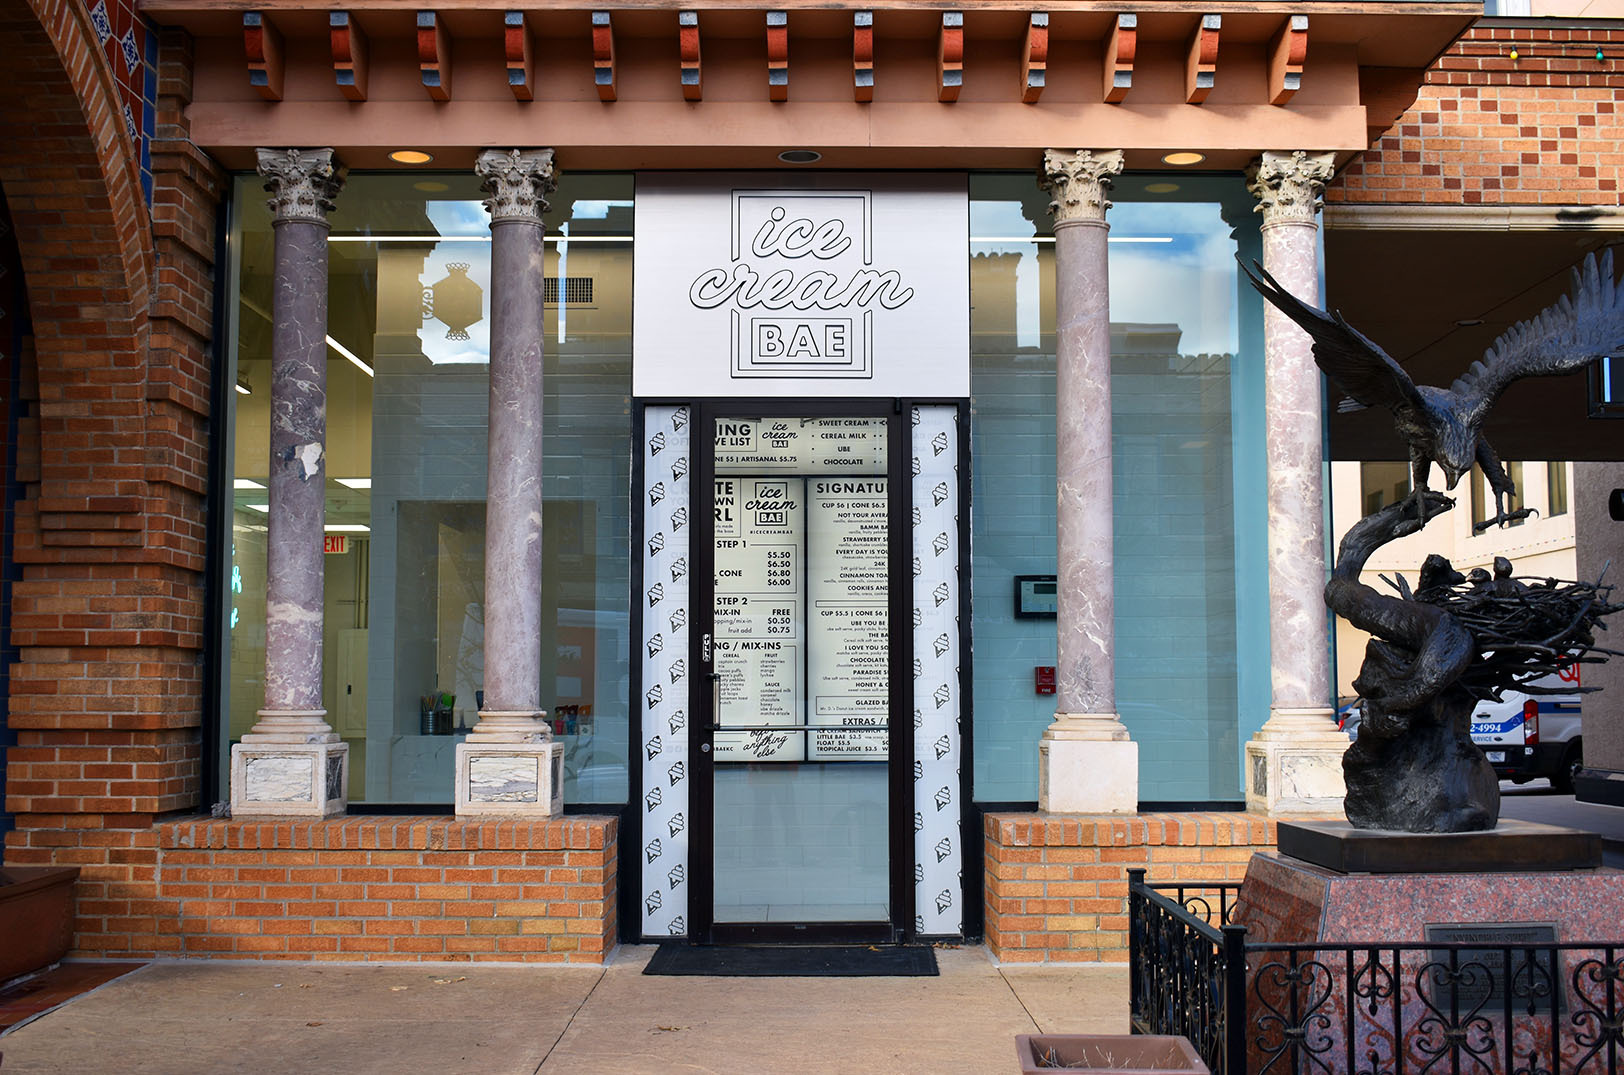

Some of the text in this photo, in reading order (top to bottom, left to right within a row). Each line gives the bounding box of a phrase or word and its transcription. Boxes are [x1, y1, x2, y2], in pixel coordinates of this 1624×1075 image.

[752, 206, 852, 260] ice
[689, 263, 915, 311] cream
[758, 324, 846, 358] BAE
[771, 422, 788, 431] ice
[761, 431, 799, 440] cream
[730, 437, 751, 446] LIST
[772, 440, 789, 448] BAE
[759, 486, 783, 498] ice
[816, 483, 888, 493] SIGNATU
[744, 500, 798, 511] cream
[759, 511, 784, 523] BAE
[324, 536, 345, 553] EXIT
[717, 540, 747, 549] STEP 1
[717, 597, 747, 605] STEP 2
[703, 634, 711, 658] PULL
[741, 642, 781, 650] MIX-INS
[842, 718, 876, 726] EXTRAS
[1470, 724, 1502, 733] 2-4994
